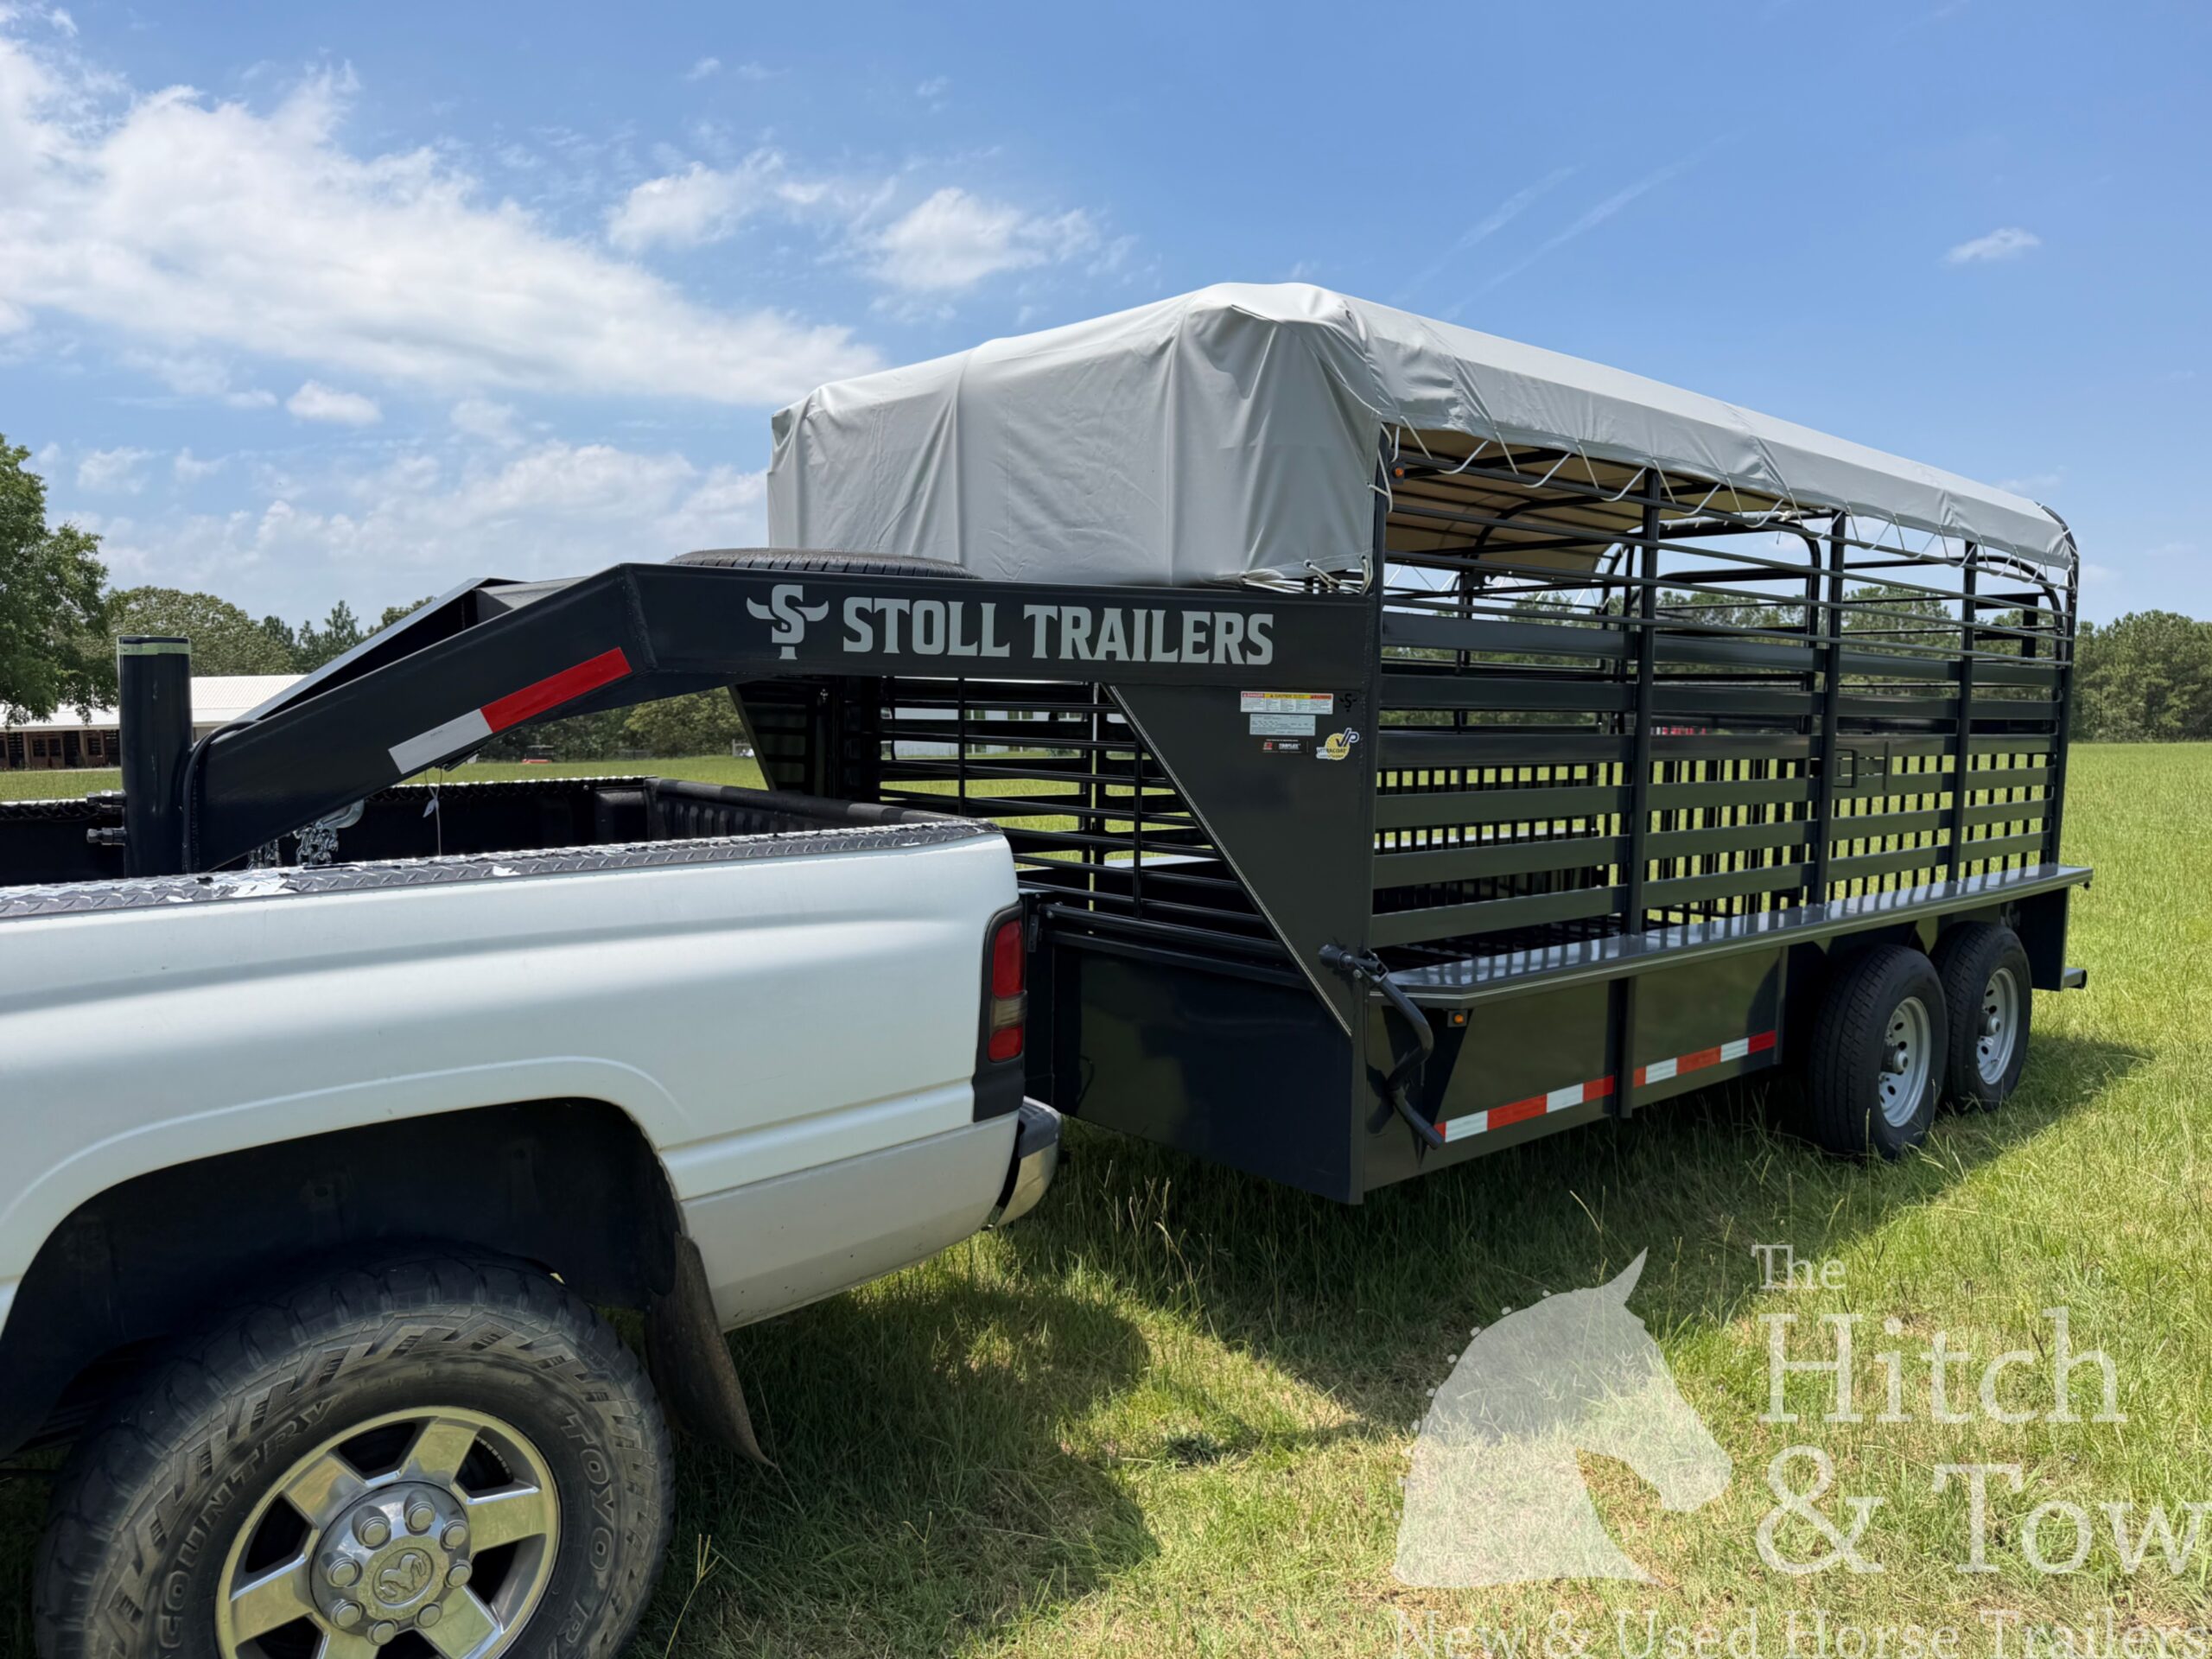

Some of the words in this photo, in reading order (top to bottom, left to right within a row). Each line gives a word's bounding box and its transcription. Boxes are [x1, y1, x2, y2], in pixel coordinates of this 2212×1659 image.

[843, 597, 1010, 658] STOLL
[1024, 605, 1274, 665] TRAILERS
[159, 1394, 340, 1649] COUNTRY
[561, 1413, 614, 1570] TOYO
